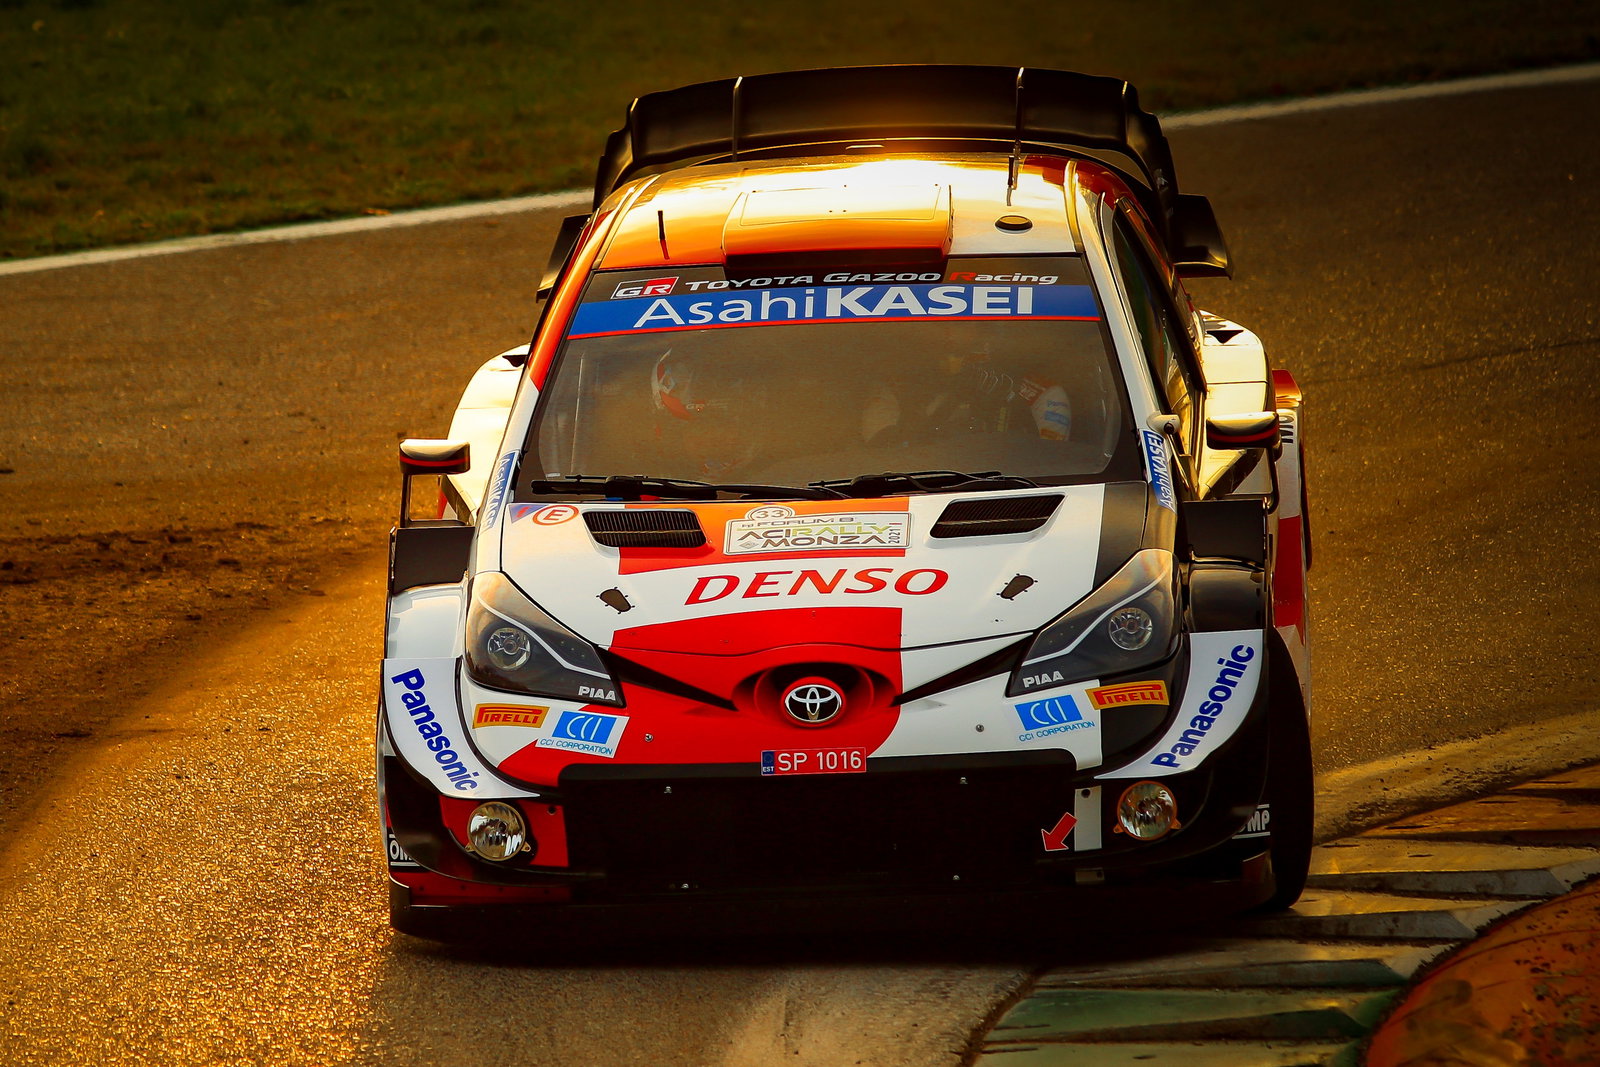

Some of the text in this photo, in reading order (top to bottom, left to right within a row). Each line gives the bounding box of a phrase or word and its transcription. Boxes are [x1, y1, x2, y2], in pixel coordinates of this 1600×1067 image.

[614, 281, 672, 298] GR
[685, 272, 1059, 291] TOYOTA GAZOO Racing
[633, 286, 1034, 328] AsahiKASEI
[755, 509, 785, 519] 33
[761, 535, 887, 549] MONZA
[888, 528, 902, 544] 2021
[684, 568, 950, 605] DENSO
[1022, 670, 1065, 689] PIAA
[578, 685, 617, 701] PIAA
[1093, 684, 1165, 706] PIRELLI
[477, 706, 543, 724] PIRELLI
[1150, 644, 1255, 768] Panasonic
[391, 668, 480, 791] Panasonic
[1018, 721, 1096, 742] CCI CORPORATION
[539, 738, 613, 756] CCI CORPORATION
[777, 750, 862, 772] SP 1016
[1239, 810, 1270, 833] MP
